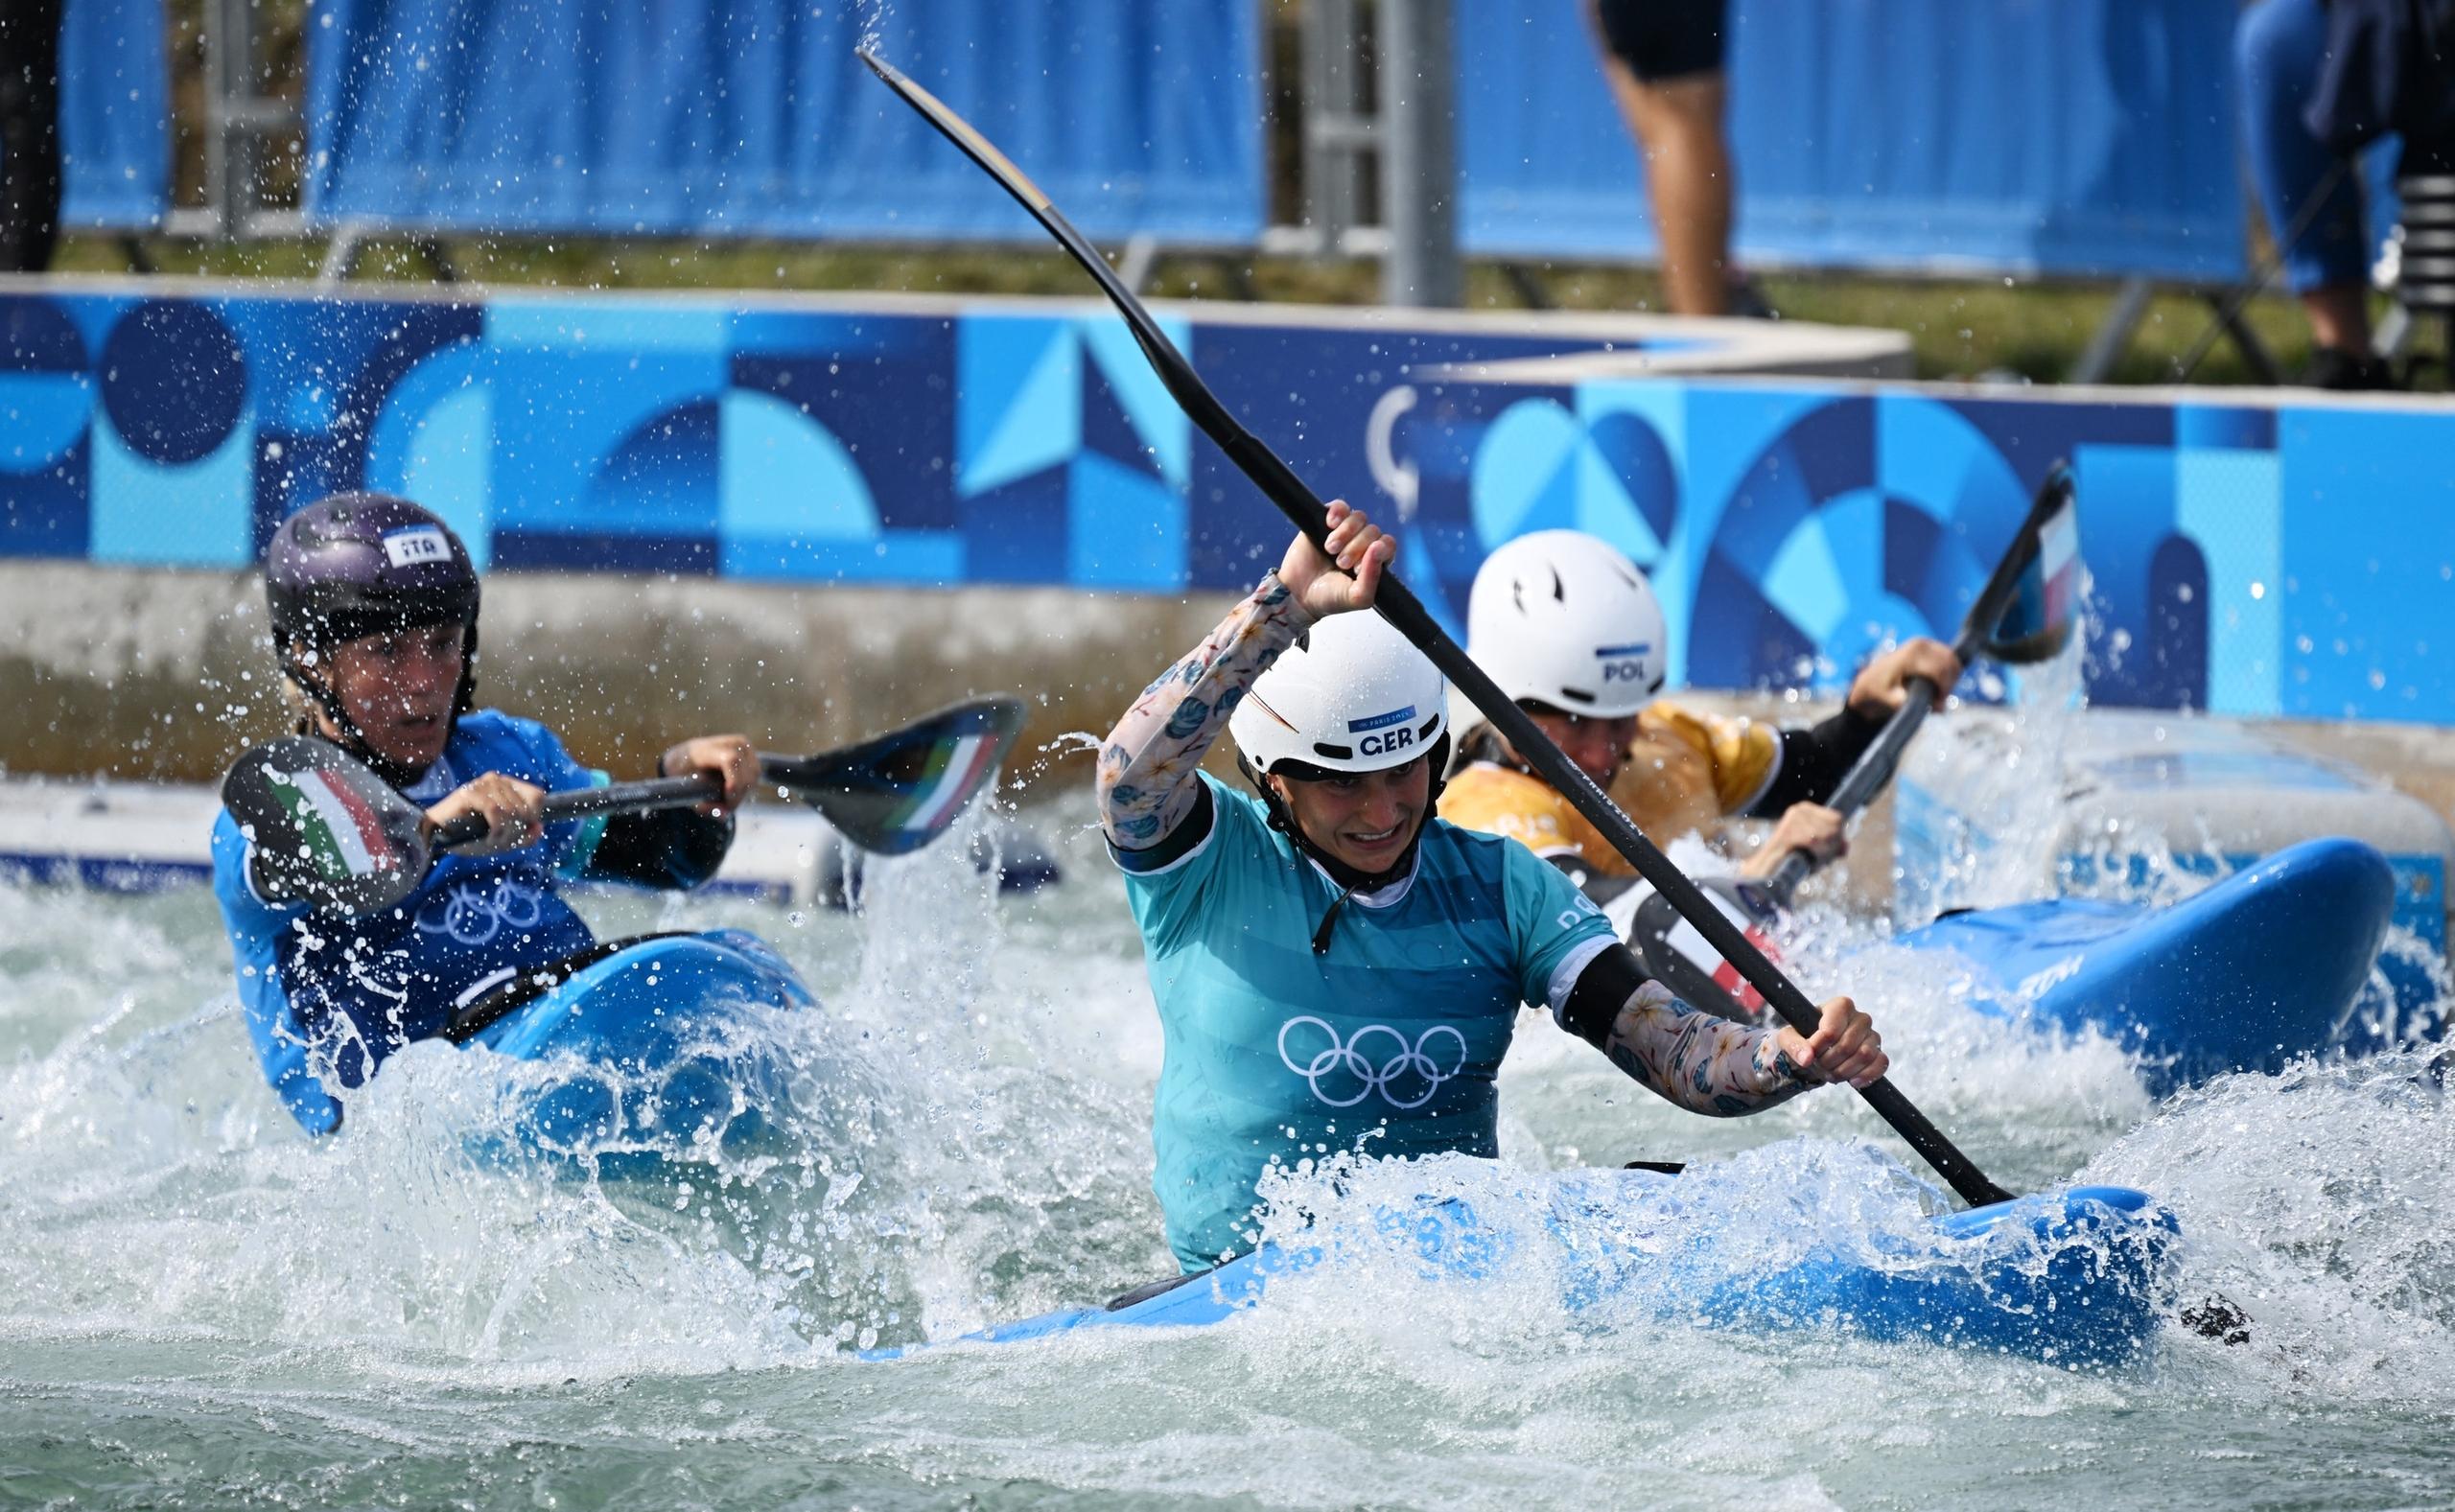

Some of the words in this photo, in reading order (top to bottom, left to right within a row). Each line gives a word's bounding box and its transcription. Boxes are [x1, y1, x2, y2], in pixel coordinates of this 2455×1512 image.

[401, 538, 437, 557] ITA
[1603, 659, 1647, 684] POL
[1360, 727, 1413, 756] GER
[1582, 773, 1613, 805] PARIS
[1613, 805, 1644, 836] 2024
